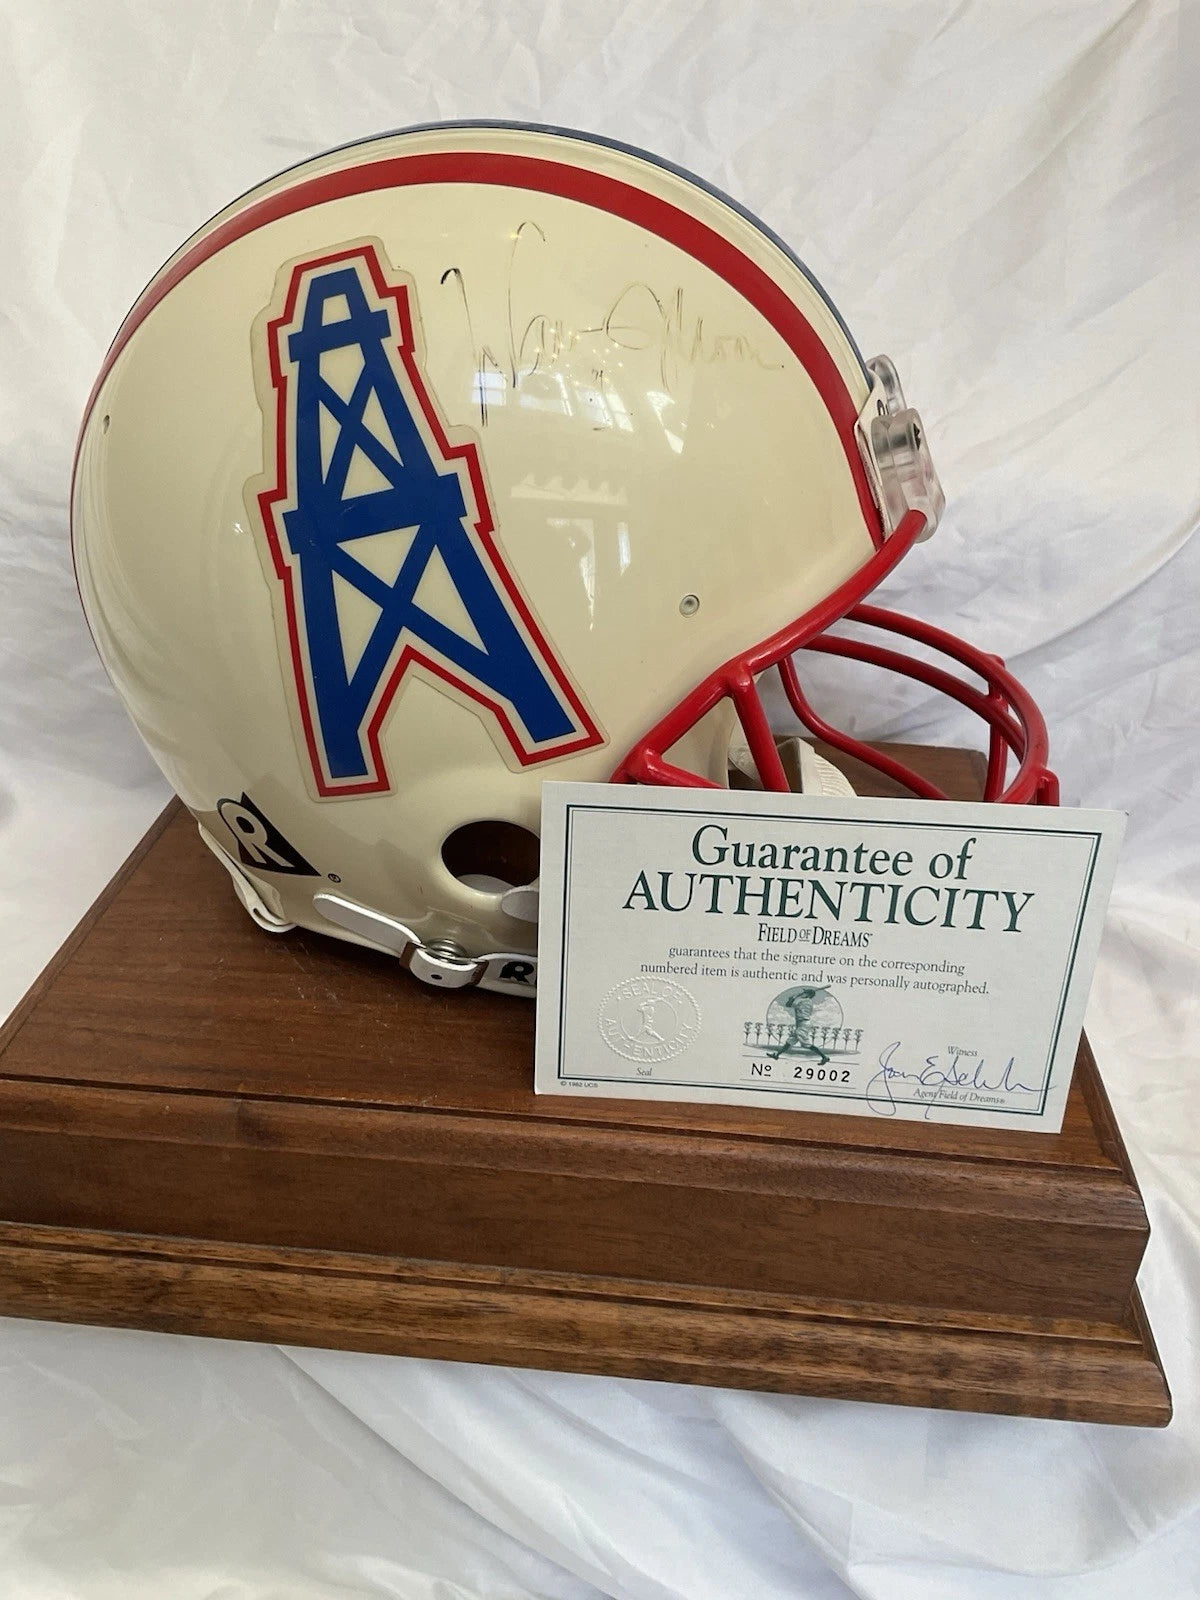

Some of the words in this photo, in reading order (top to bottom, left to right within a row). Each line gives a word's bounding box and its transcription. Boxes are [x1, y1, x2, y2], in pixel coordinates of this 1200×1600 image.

[692, 824, 913, 877] Guarantee
[929, 837, 977, 880] of
[622, 869, 1035, 933] AUTHENTICITY
[758, 922, 798, 943] FIELD
[799, 928, 812, 942] OF
[499, 960, 535, 984] R
[668, 946, 731, 959] guarantees
[733, 947, 757, 961] that
[761, 949, 780, 962] the
[782, 951, 836, 965] signature
[839, 955, 855, 966] on
[858, 955, 878, 968] the
[880, 959, 966, 976] corresponding
[640, 961, 698, 976] numbered
[701, 964, 727, 977] item
[730, 966, 739, 977] is
[742, 967, 799, 981] authentic
[801, 970, 823, 983] and
[826, 973, 848, 984] was
[850, 975, 911, 991] personally
[912, 979, 990, 996] autographed.
[947, 1045, 978, 1057] Witness
[636, 1067, 653, 1077] Seal
[793, 1066, 851, 1083] 29002
[938, 1088, 958, 1100] Field
[959, 1090, 968, 1102] of
